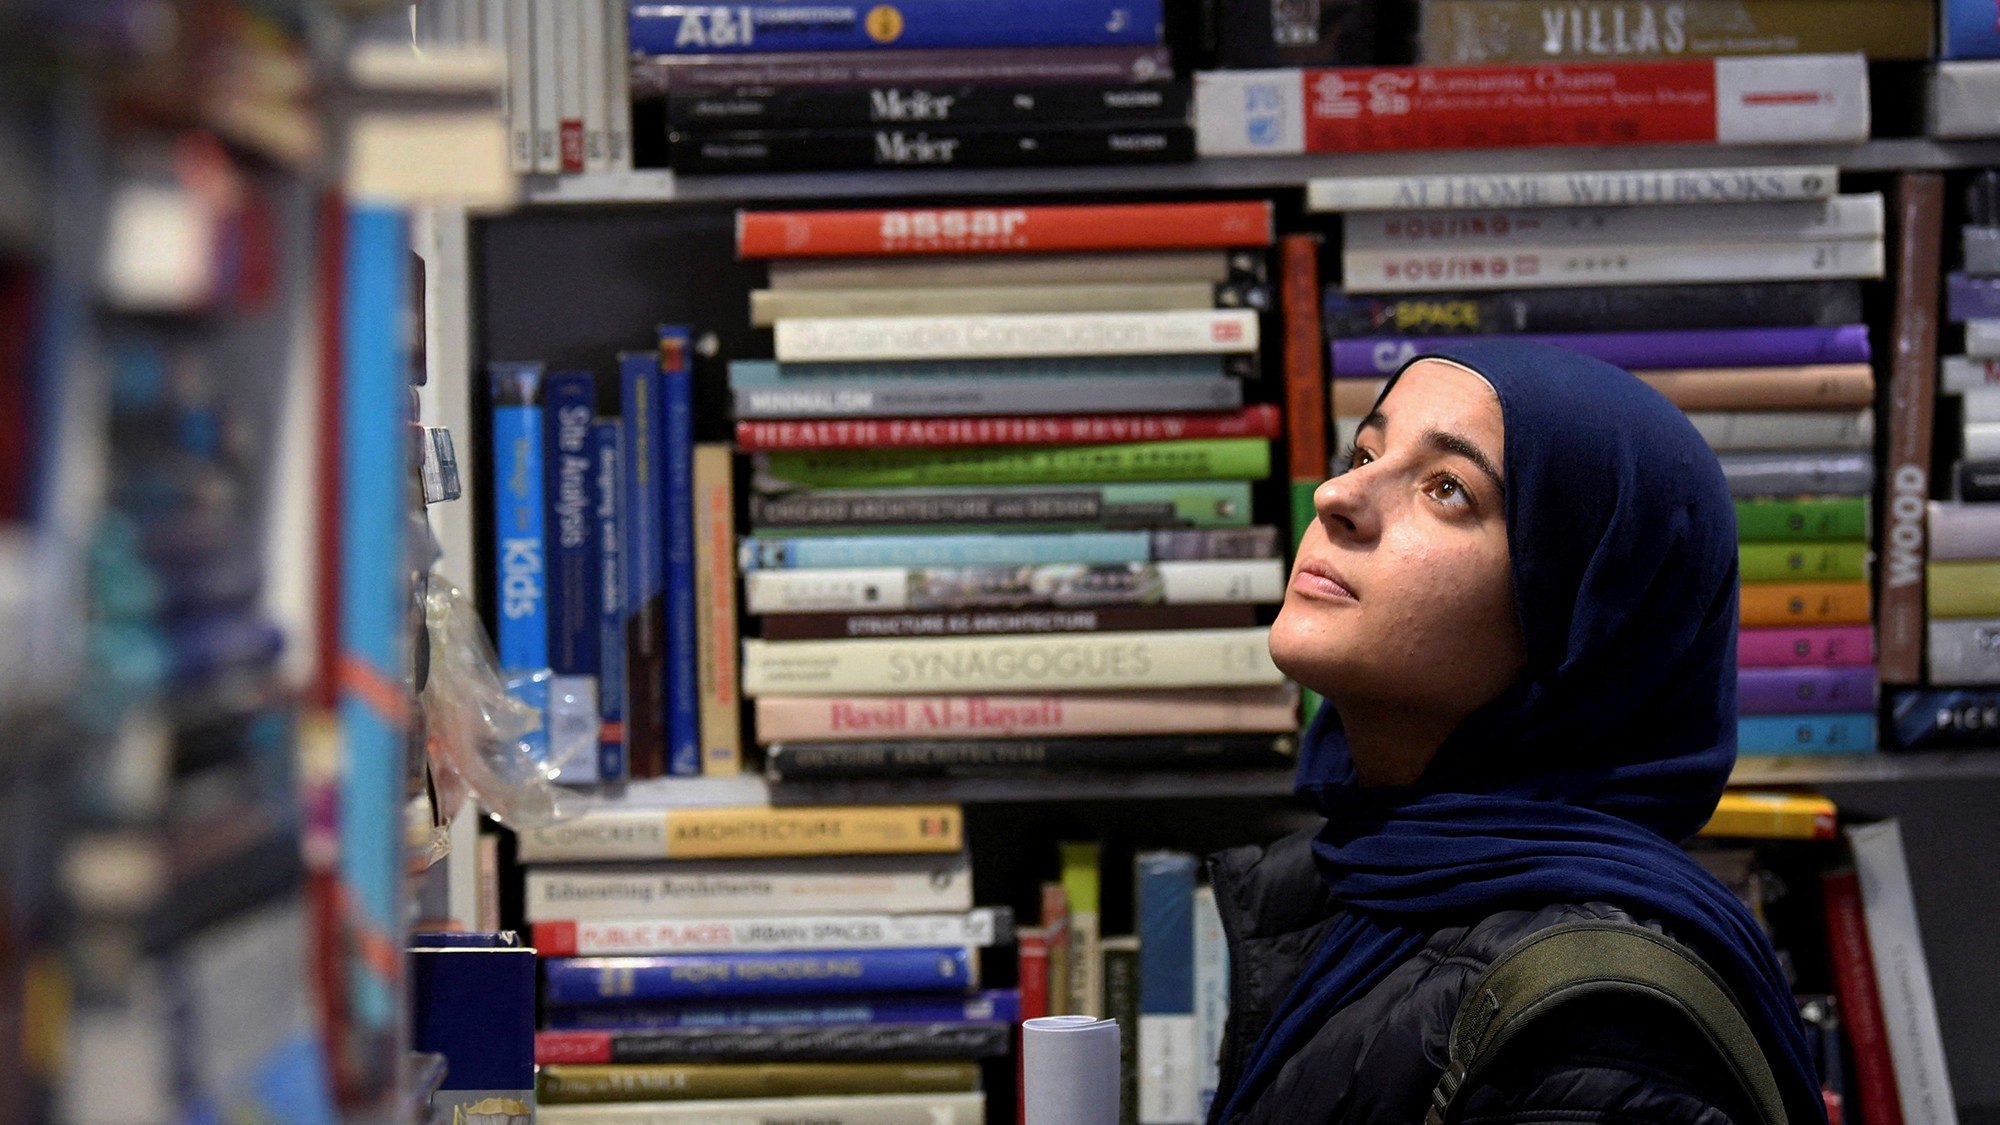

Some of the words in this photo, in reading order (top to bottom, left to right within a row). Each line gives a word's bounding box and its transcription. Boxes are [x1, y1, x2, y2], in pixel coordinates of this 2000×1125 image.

[675, 6, 753, 47] A&I
[1542, 5, 1686, 55] VILLAS
[1419, 71, 1526, 92] Romantic
[1535, 67, 1617, 90] Charm
[870, 88, 956, 121] Meier
[874, 130, 959, 164] Meier
[1393, 181, 1446, 208] AT
[1448, 178, 1551, 206] HOME
[1566, 175, 1671, 202] WITH
[1674, 171, 1785, 199] BOOKS
[880, 210, 1028, 238] assar
[1395, 300, 1479, 328] SPACE
[964, 318, 1146, 349] Construction
[749, 391, 874, 413] MINIMALISM
[558, 404, 590, 452] Site
[754, 421, 879, 446] HEALTH
[890, 418, 1061, 443] FACILITIES
[1072, 415, 1187, 439] REVIEW
[555, 455, 588, 549] Analysis
[850, 499, 991, 522] ARCHITECTURE
[1889, 464, 1926, 588] WOOD
[502, 536, 543, 620] Kids
[847, 615, 944, 636] STRUCTURE
[979, 611, 1098, 633] ARCHITECTURE
[887, 643, 1153, 682] SYNAGOGUES
[830, 700, 908, 731] Basil
[919, 697, 1064, 735] Al-Bayati
[1935, 707, 1999, 729] PICK
[674, 820, 842, 842] ARCHITECTURE
[581, 924, 652, 946] PUBLIC
[659, 922, 732, 945] PLACES
[736, 922, 805, 944] URBAN
[809, 920, 883, 941] SPACES
